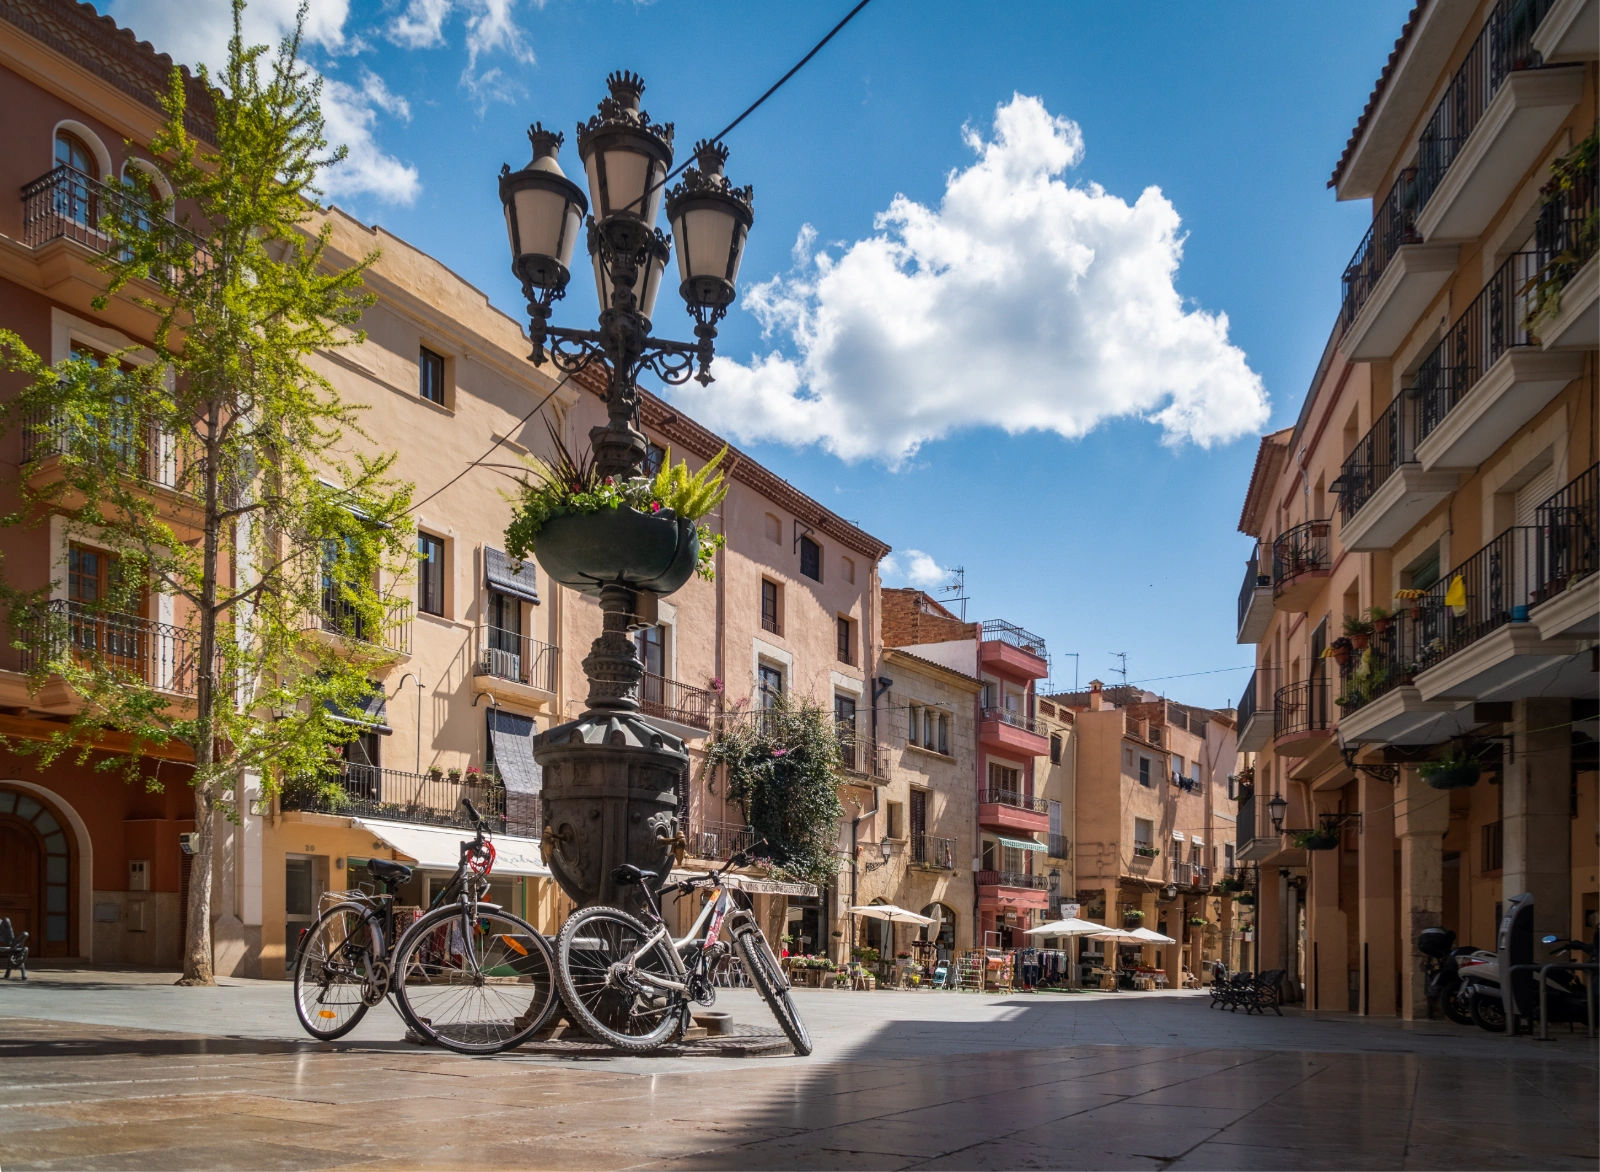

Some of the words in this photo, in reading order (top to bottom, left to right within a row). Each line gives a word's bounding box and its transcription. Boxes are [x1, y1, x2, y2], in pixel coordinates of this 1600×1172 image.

[304, 844, 315, 852] 20
[669, 875, 678, 883] LA
[745, 882, 758, 892] VINS
